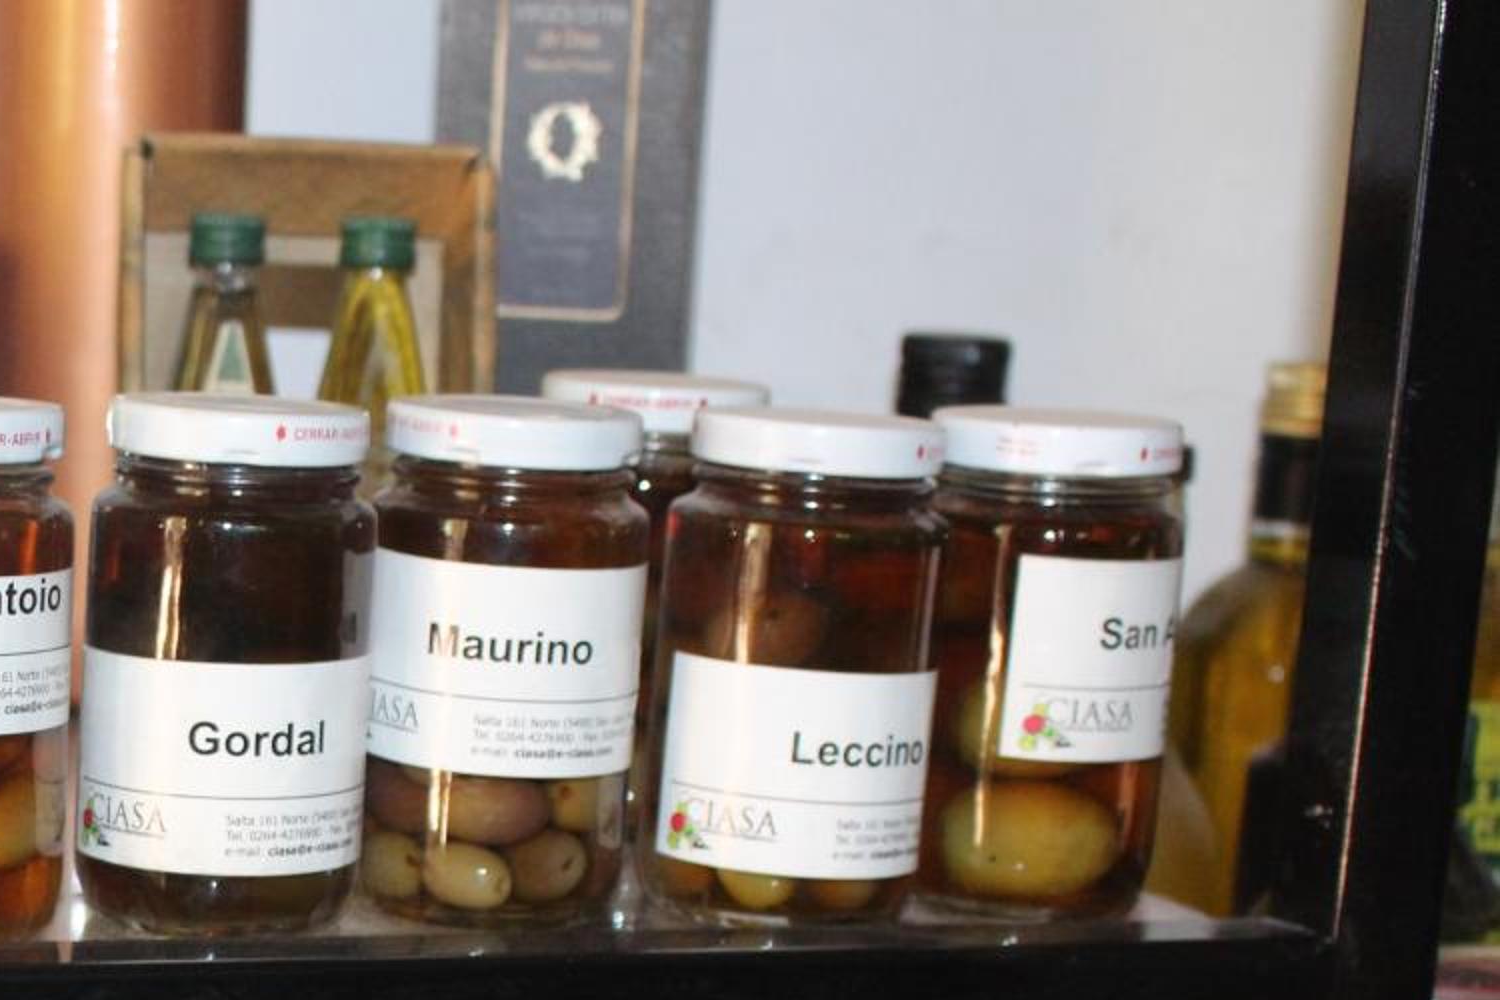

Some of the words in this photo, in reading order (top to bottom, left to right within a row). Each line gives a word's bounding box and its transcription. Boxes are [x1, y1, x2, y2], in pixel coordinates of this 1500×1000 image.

[527, 100, 601, 182] Q
[428, 621, 594, 665] Maurino
[1100, 616, 1158, 650] San
[371, 687, 419, 727] IASA
[187, 720, 326, 758] Gordal
[790, 731, 924, 768] Leccino
